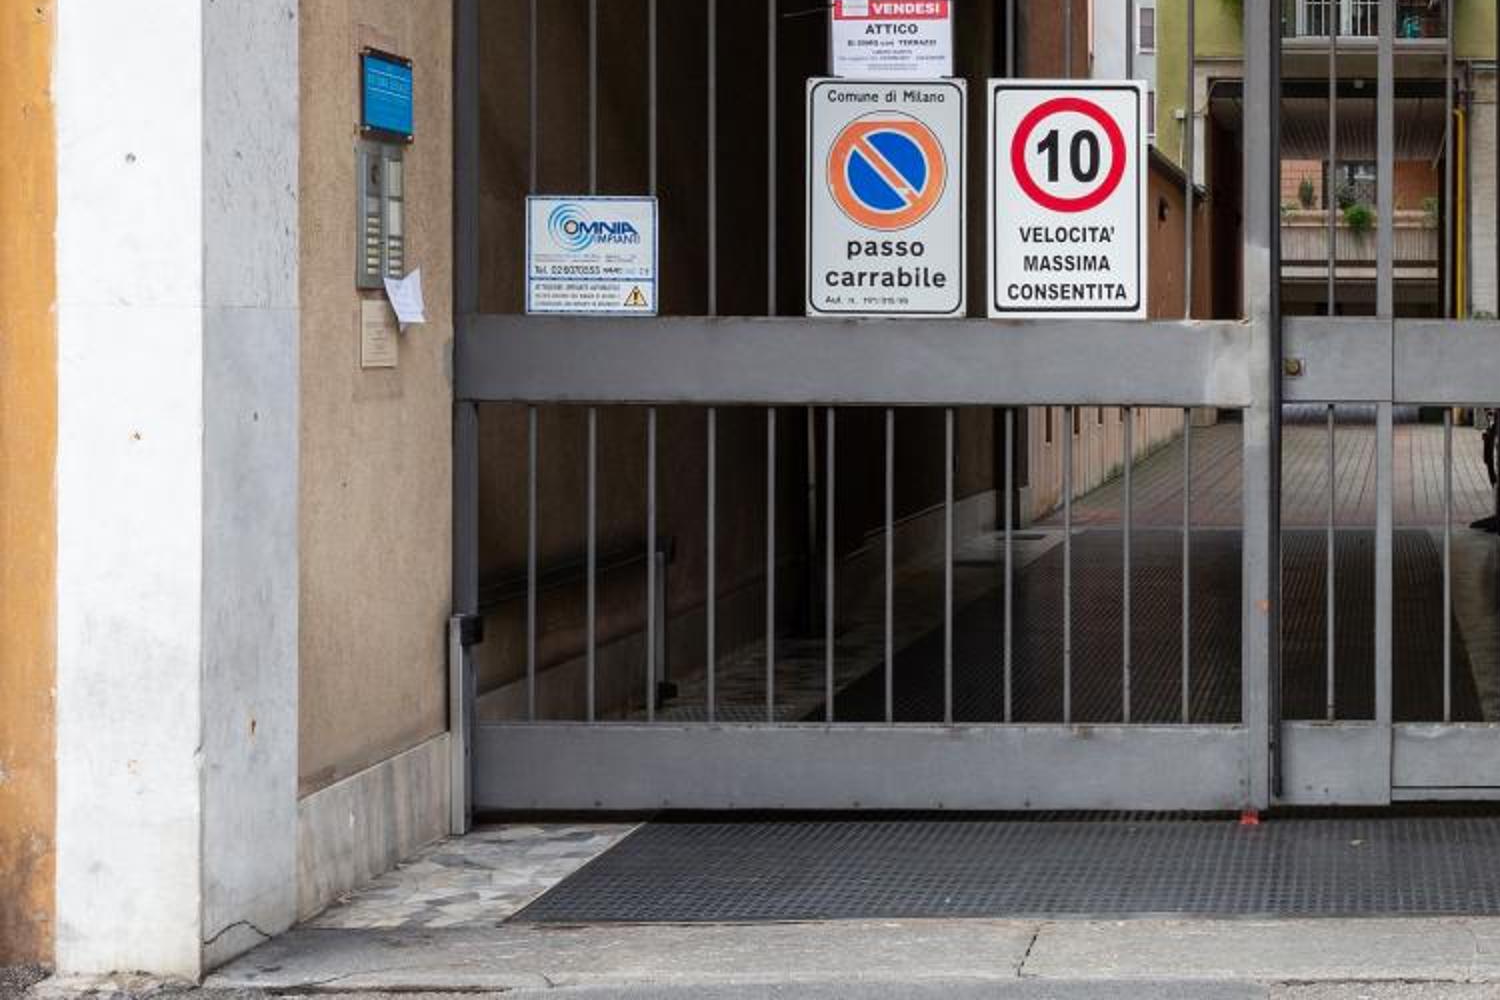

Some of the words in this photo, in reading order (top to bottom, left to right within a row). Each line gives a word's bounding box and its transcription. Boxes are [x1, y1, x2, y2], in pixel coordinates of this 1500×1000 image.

[871, 3, 939, 15] VENDESI
[865, 23, 919, 35] ATTICO
[827, 89, 879, 103] Comune
[885, 89, 897, 103] di
[903, 89, 945, 103] Milano
[1037, 129, 1101, 183] 10
[564, 220, 638, 235] OMNIA
[1019, 226, 1115, 243] VELOCITA'
[847, 240, 925, 260] passo
[1023, 255, 1111, 271] MASSIMA
[825, 267, 947, 288] carrabile
[1007, 283, 1127, 300] CONSENTITA
